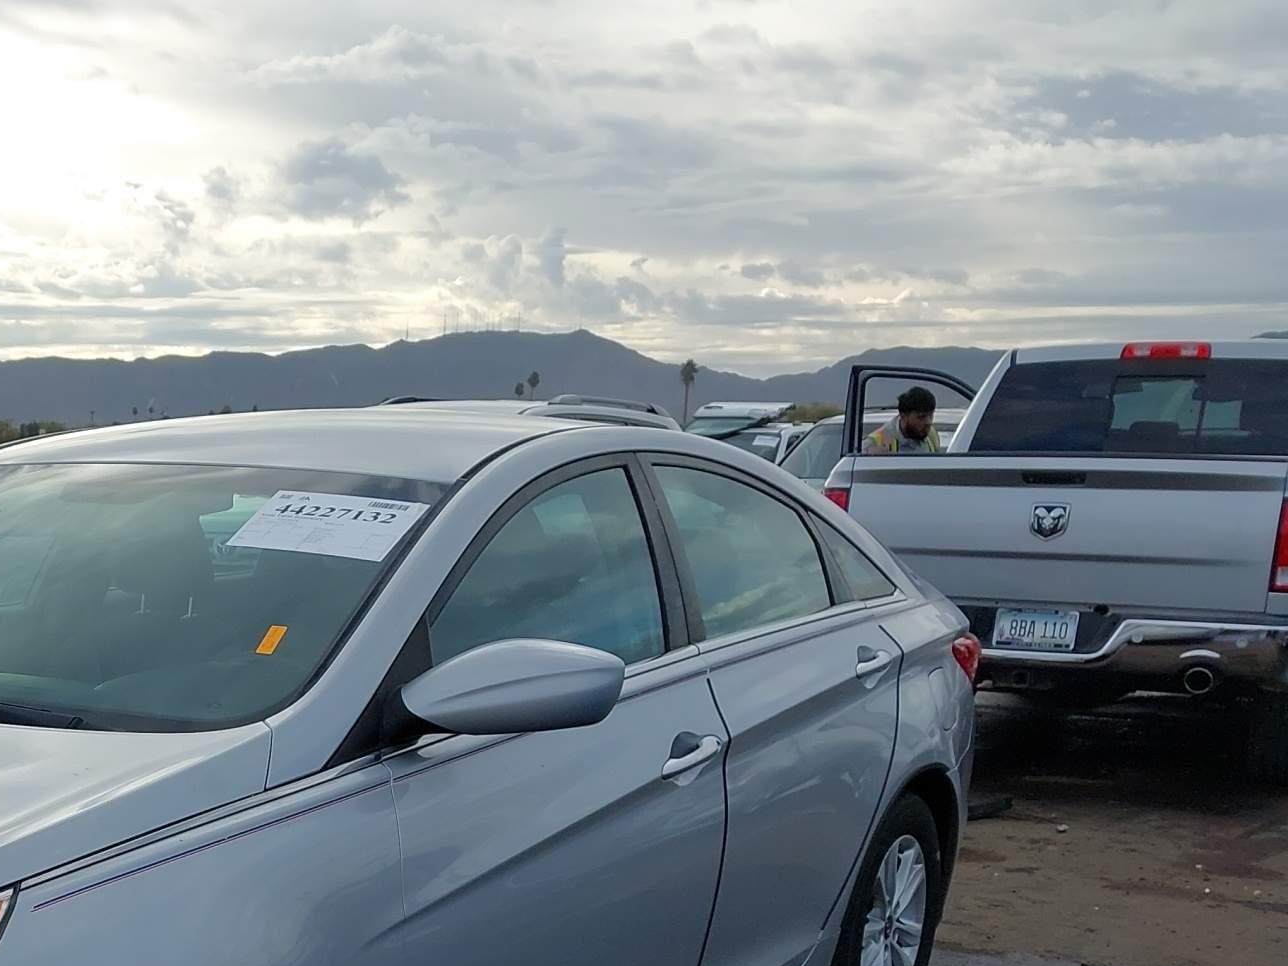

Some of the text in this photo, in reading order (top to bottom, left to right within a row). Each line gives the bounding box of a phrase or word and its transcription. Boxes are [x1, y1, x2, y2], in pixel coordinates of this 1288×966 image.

[274, 503, 398, 525] 44227132
[1009, 619, 1069, 640] 8BA 110
